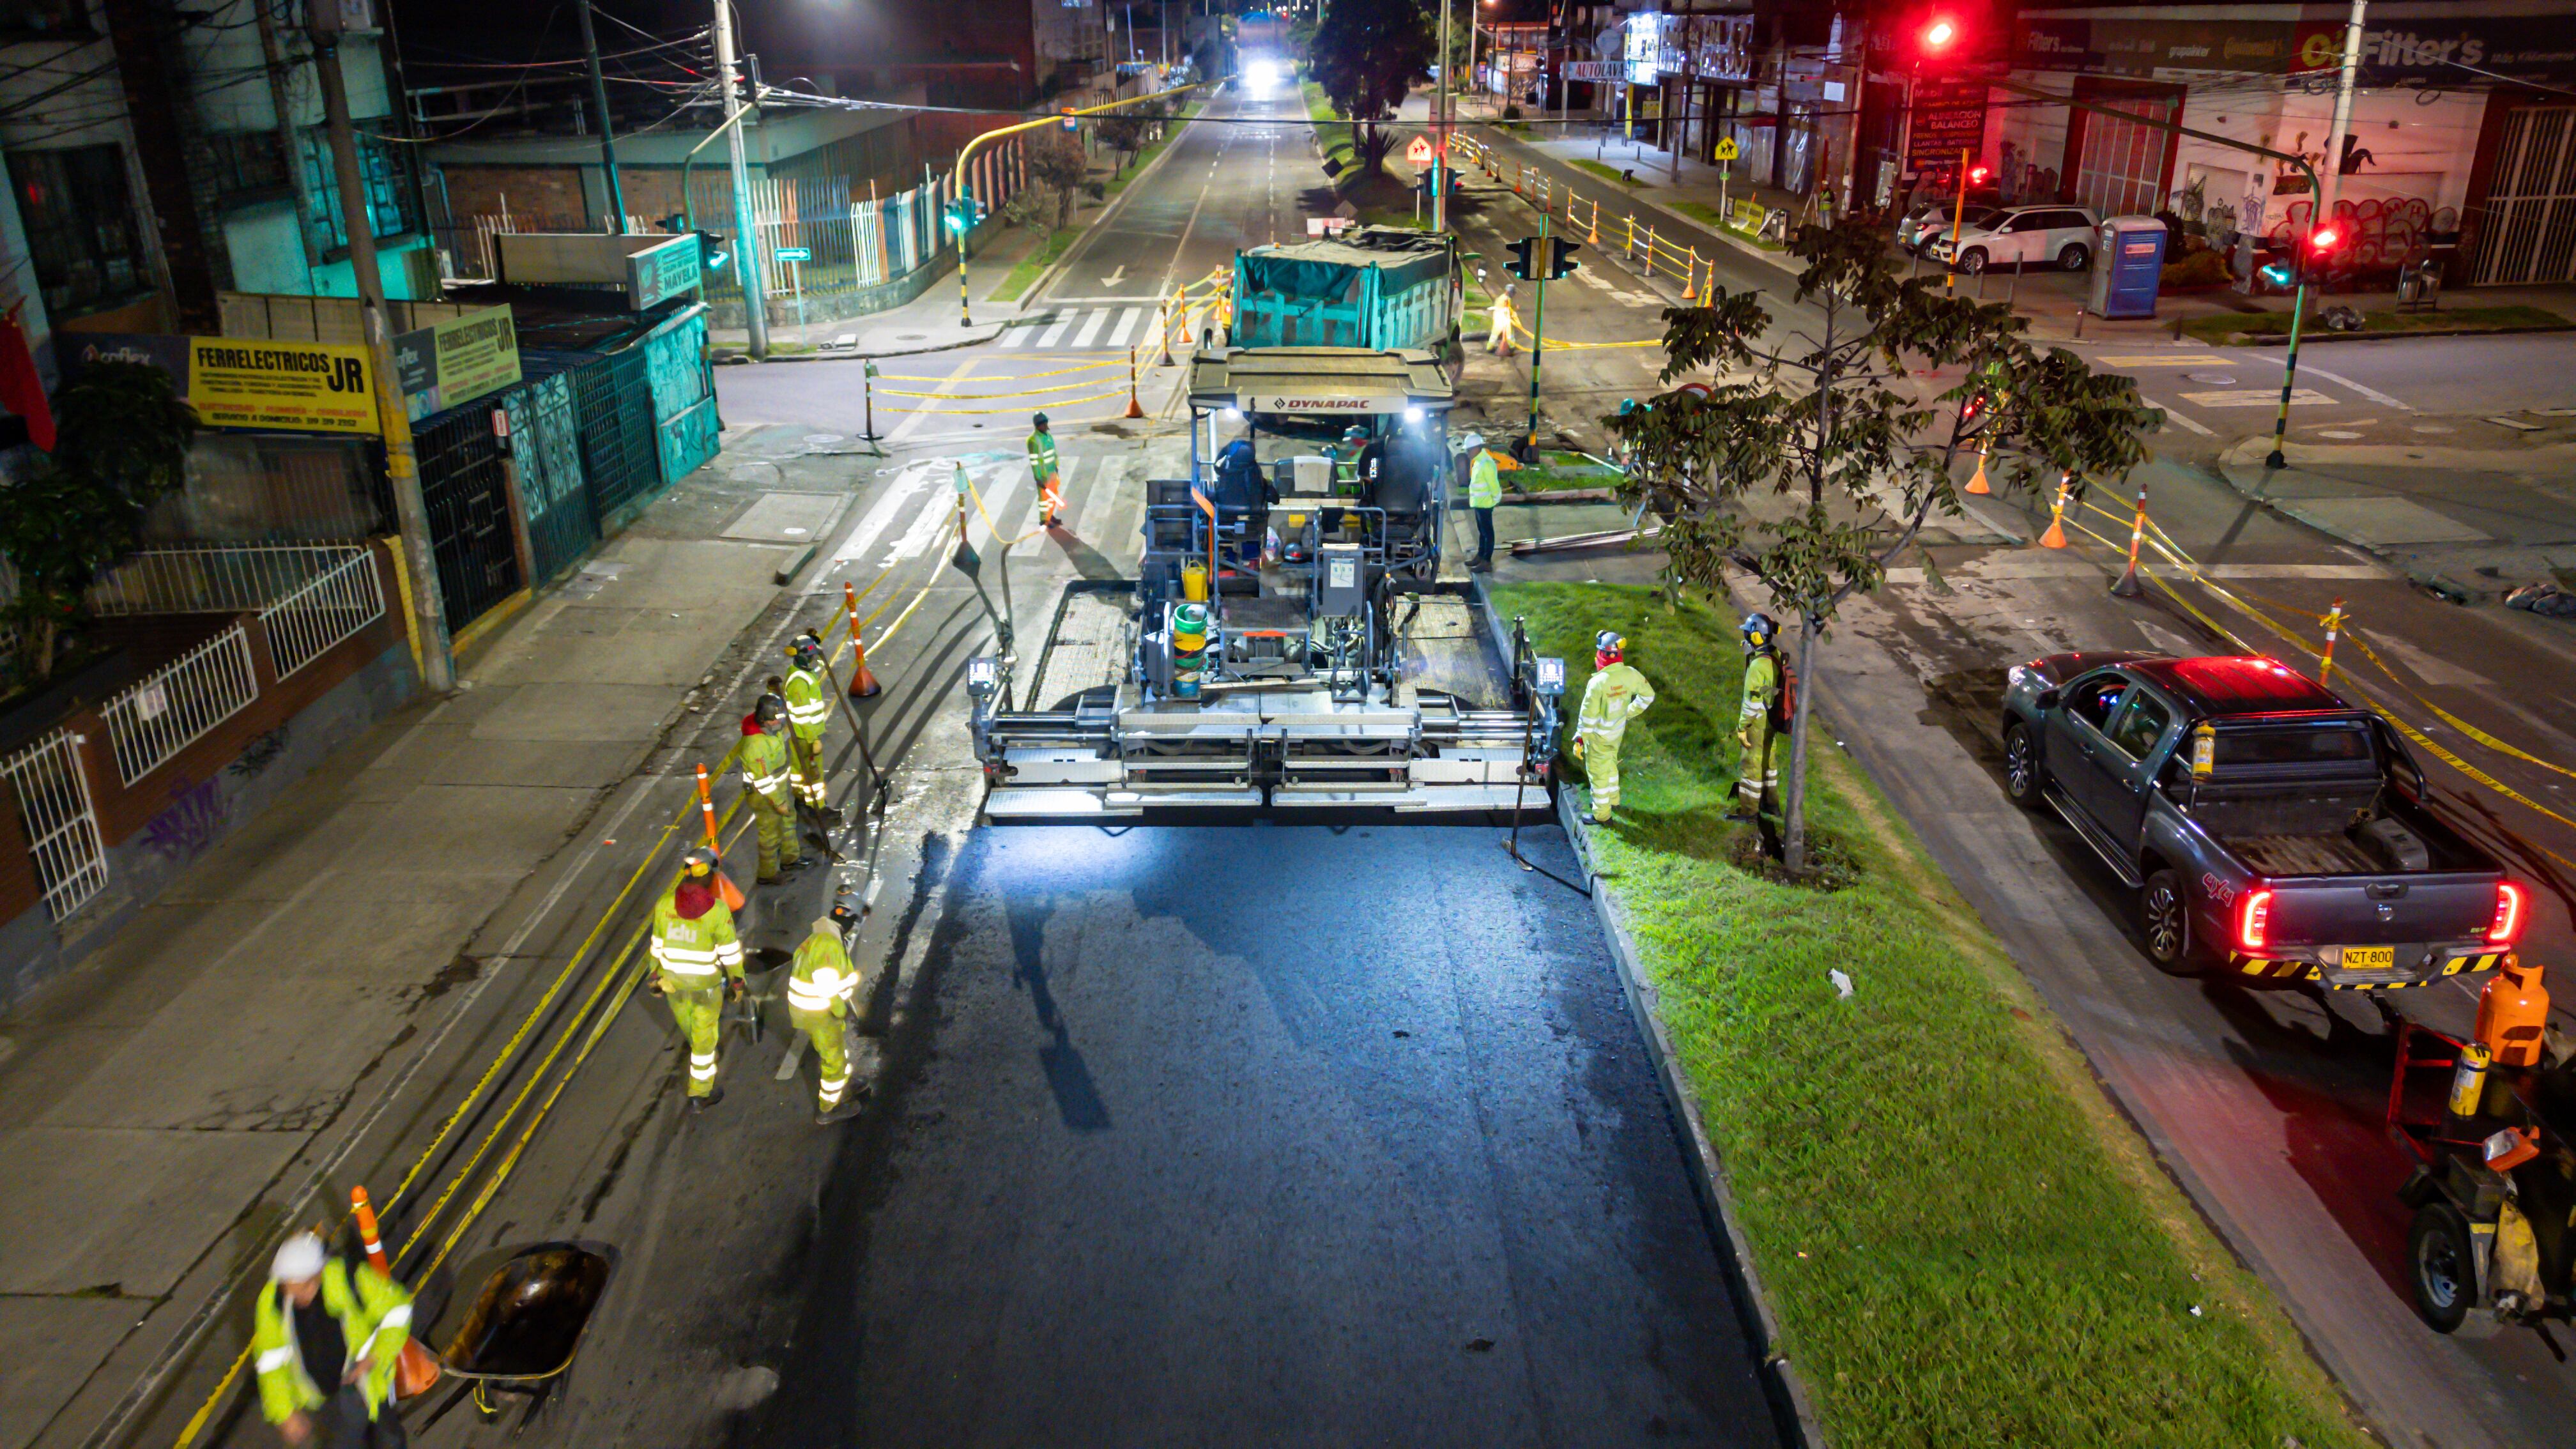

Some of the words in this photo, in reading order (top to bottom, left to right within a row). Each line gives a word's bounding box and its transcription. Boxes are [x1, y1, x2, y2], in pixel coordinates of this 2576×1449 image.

[2302, 30, 2343, 67] Oi
[2361, 29, 2484, 66] Filter's
[1931, 119, 1978, 129] BALANCEO
[1912, 147, 1979, 157] SINCRONIZACON
[197, 347, 330, 372] FERRELECTRICOS
[326, 357, 365, 394] JR
[1288, 400, 1369, 408] DYNAPAC
